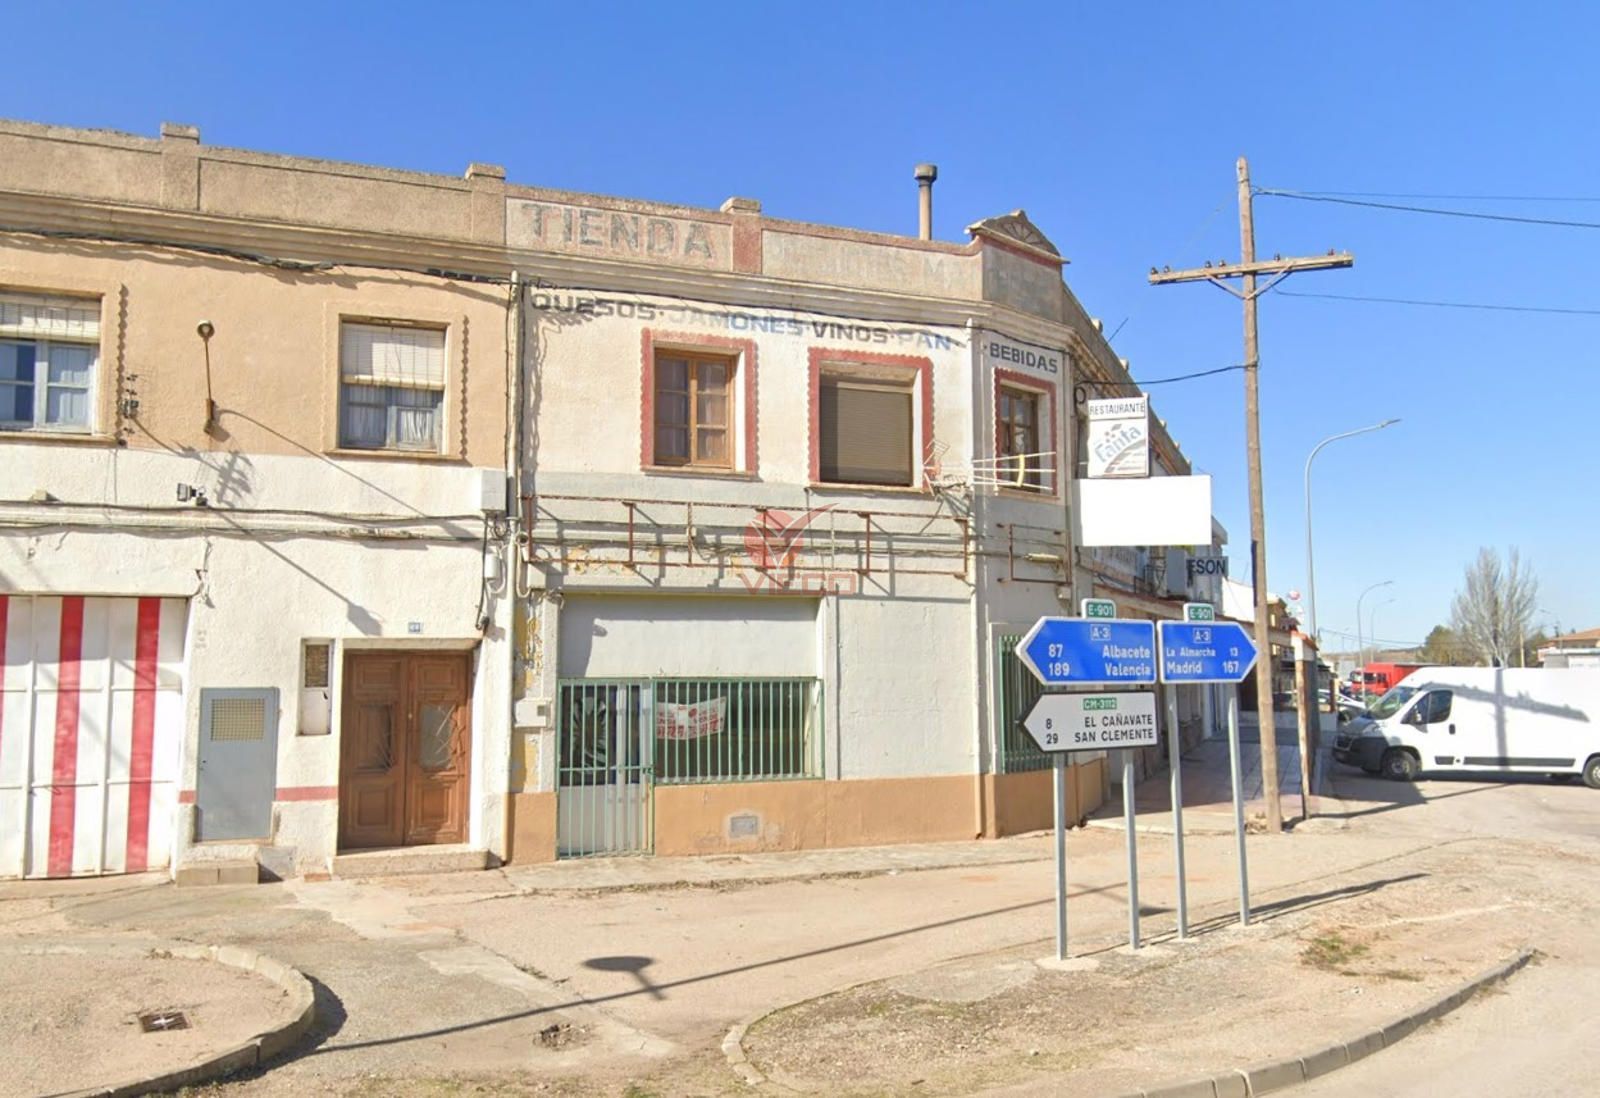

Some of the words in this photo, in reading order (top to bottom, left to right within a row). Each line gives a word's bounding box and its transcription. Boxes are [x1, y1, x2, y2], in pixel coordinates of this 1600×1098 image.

[521, 202, 715, 259] TIENDA
[531, 292, 655, 321] QUESOS
[667, 308, 804, 337] JAMONES
[811, 321, 888, 345] VINOS
[898, 330, 952, 352] PAN
[989, 342, 1059, 375] BEBIDAS
[1089, 403, 1145, 415] RESTAURANTE
[1186, 558, 1227, 575] ESON
[1088, 605, 1113, 616] E-901
[1190, 608, 1213, 620] E-901
[1093, 627, 1109, 638] A-3
[1195, 631, 1210, 641] A-3
[1048, 644, 1063, 658] 87
[1103, 646, 1151, 658] Albacete
[1167, 647, 1176, 657] La
[1180, 647, 1216, 657] Almarcha
[1230, 648, 1238, 656] 13
[1049, 664, 1070, 676] 189
[1105, 664, 1151, 676] Valencia
[1167, 661, 1202, 673] Madrid
[1223, 661, 1238, 673] 167
[1046, 719, 1052, 730] 8
[1085, 717, 1096, 727] EL
[1102, 714, 1153, 727] CAÑAVATE
[1046, 733, 1058, 744] 29
[1075, 732, 1096, 742] SAN
[1102, 729, 1154, 741] CLEMENTE
